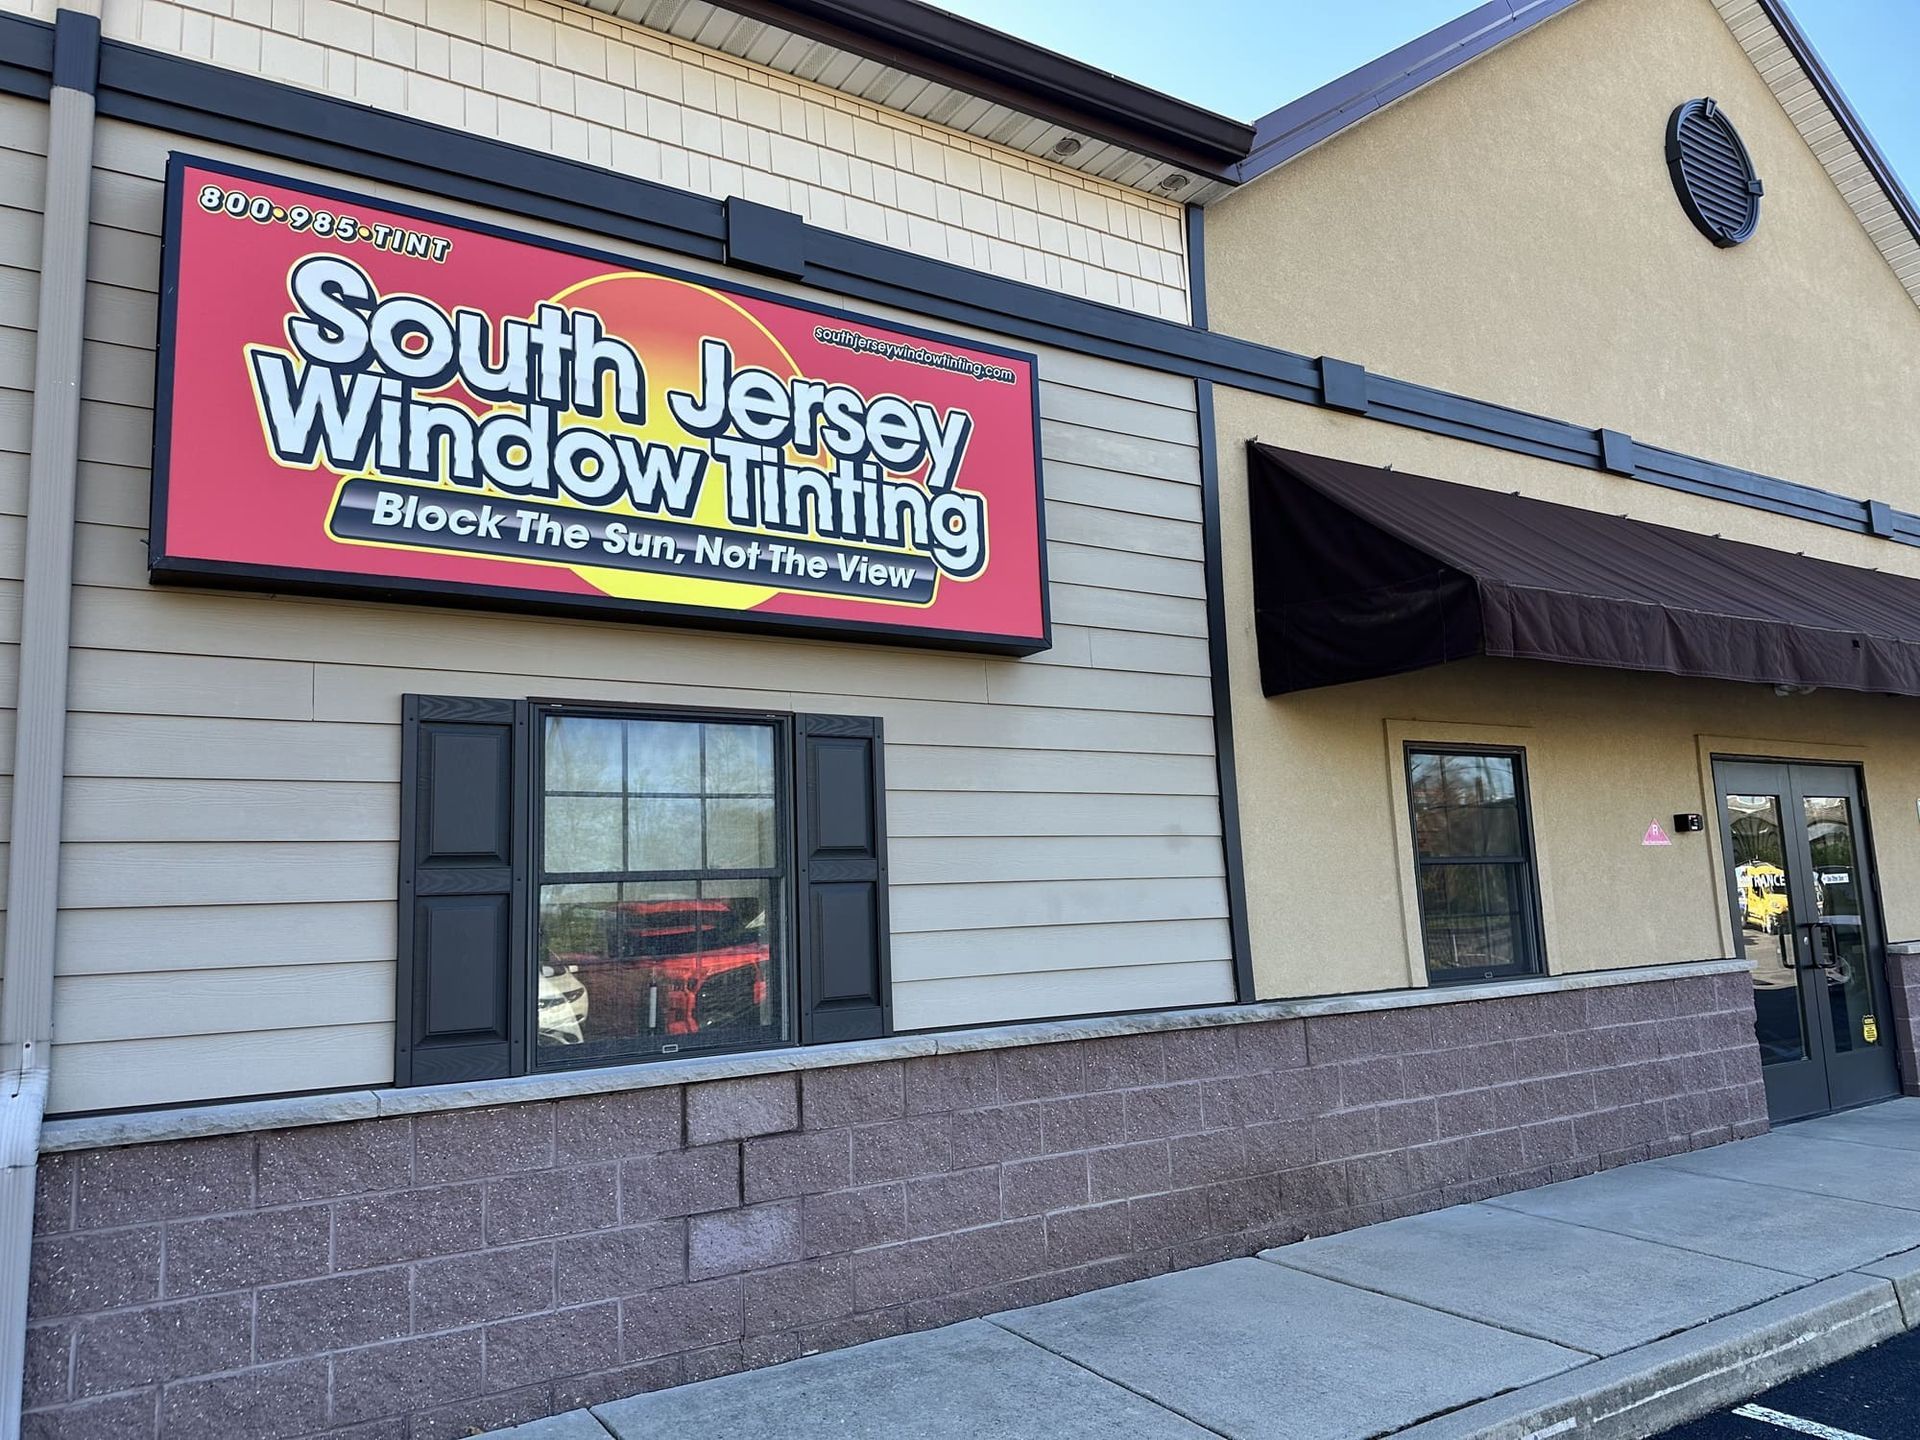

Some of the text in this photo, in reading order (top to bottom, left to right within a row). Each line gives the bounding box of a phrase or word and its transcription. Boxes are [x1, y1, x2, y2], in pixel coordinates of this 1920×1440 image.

[288, 257, 970, 488] South Jersey
[815, 327, 1014, 381] southjerseywindowtinting.com
[253, 353, 981, 573] Window Tinting
[372, 491, 916, 589] Block The Sun, Not The View
[1652, 824, 1659, 836] R
